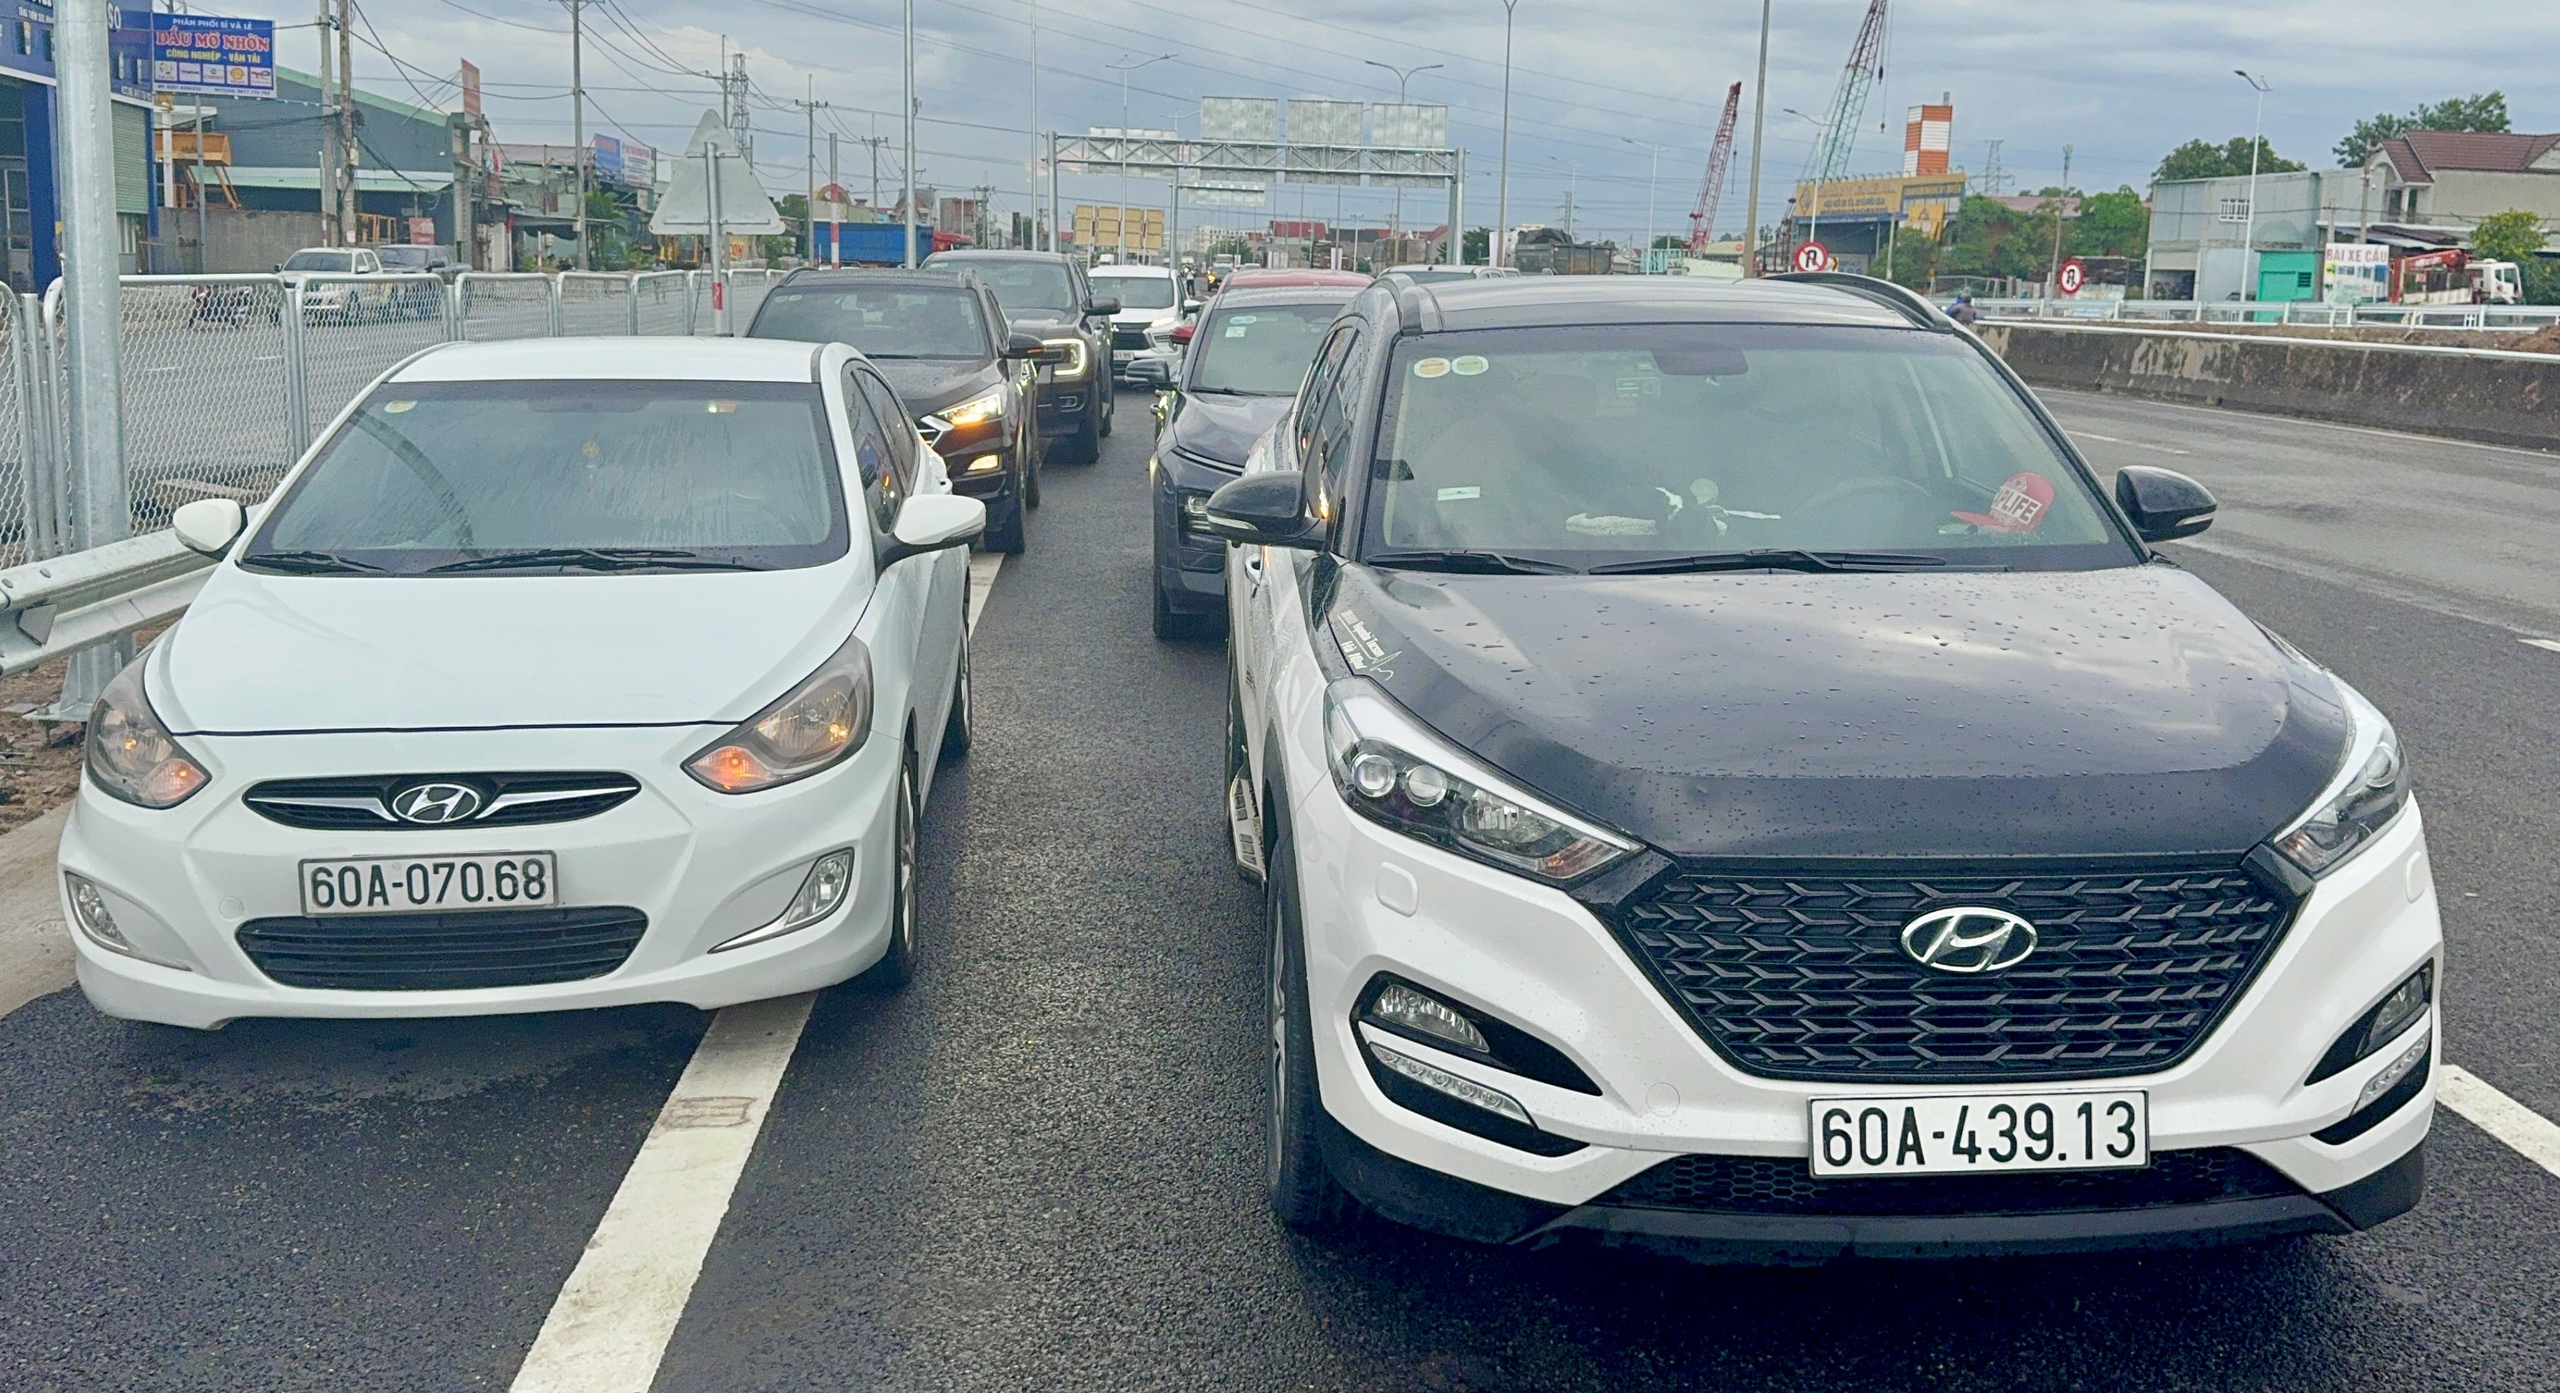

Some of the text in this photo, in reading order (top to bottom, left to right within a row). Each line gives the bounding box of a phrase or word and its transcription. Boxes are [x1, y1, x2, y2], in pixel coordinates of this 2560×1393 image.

[230, 22, 243, 30] VÀ
[195, 31, 220, 49] MỠ
[166, 48, 190, 59] CÔNG
[190, 50, 221, 62] NGHIỆP
[228, 53, 246, 64] VẬN
[2348, 249, 2362, 262] XE
[310, 858, 547, 908] 60A-070.68
[1822, 1100, 2136, 1167] 60A-439.13
